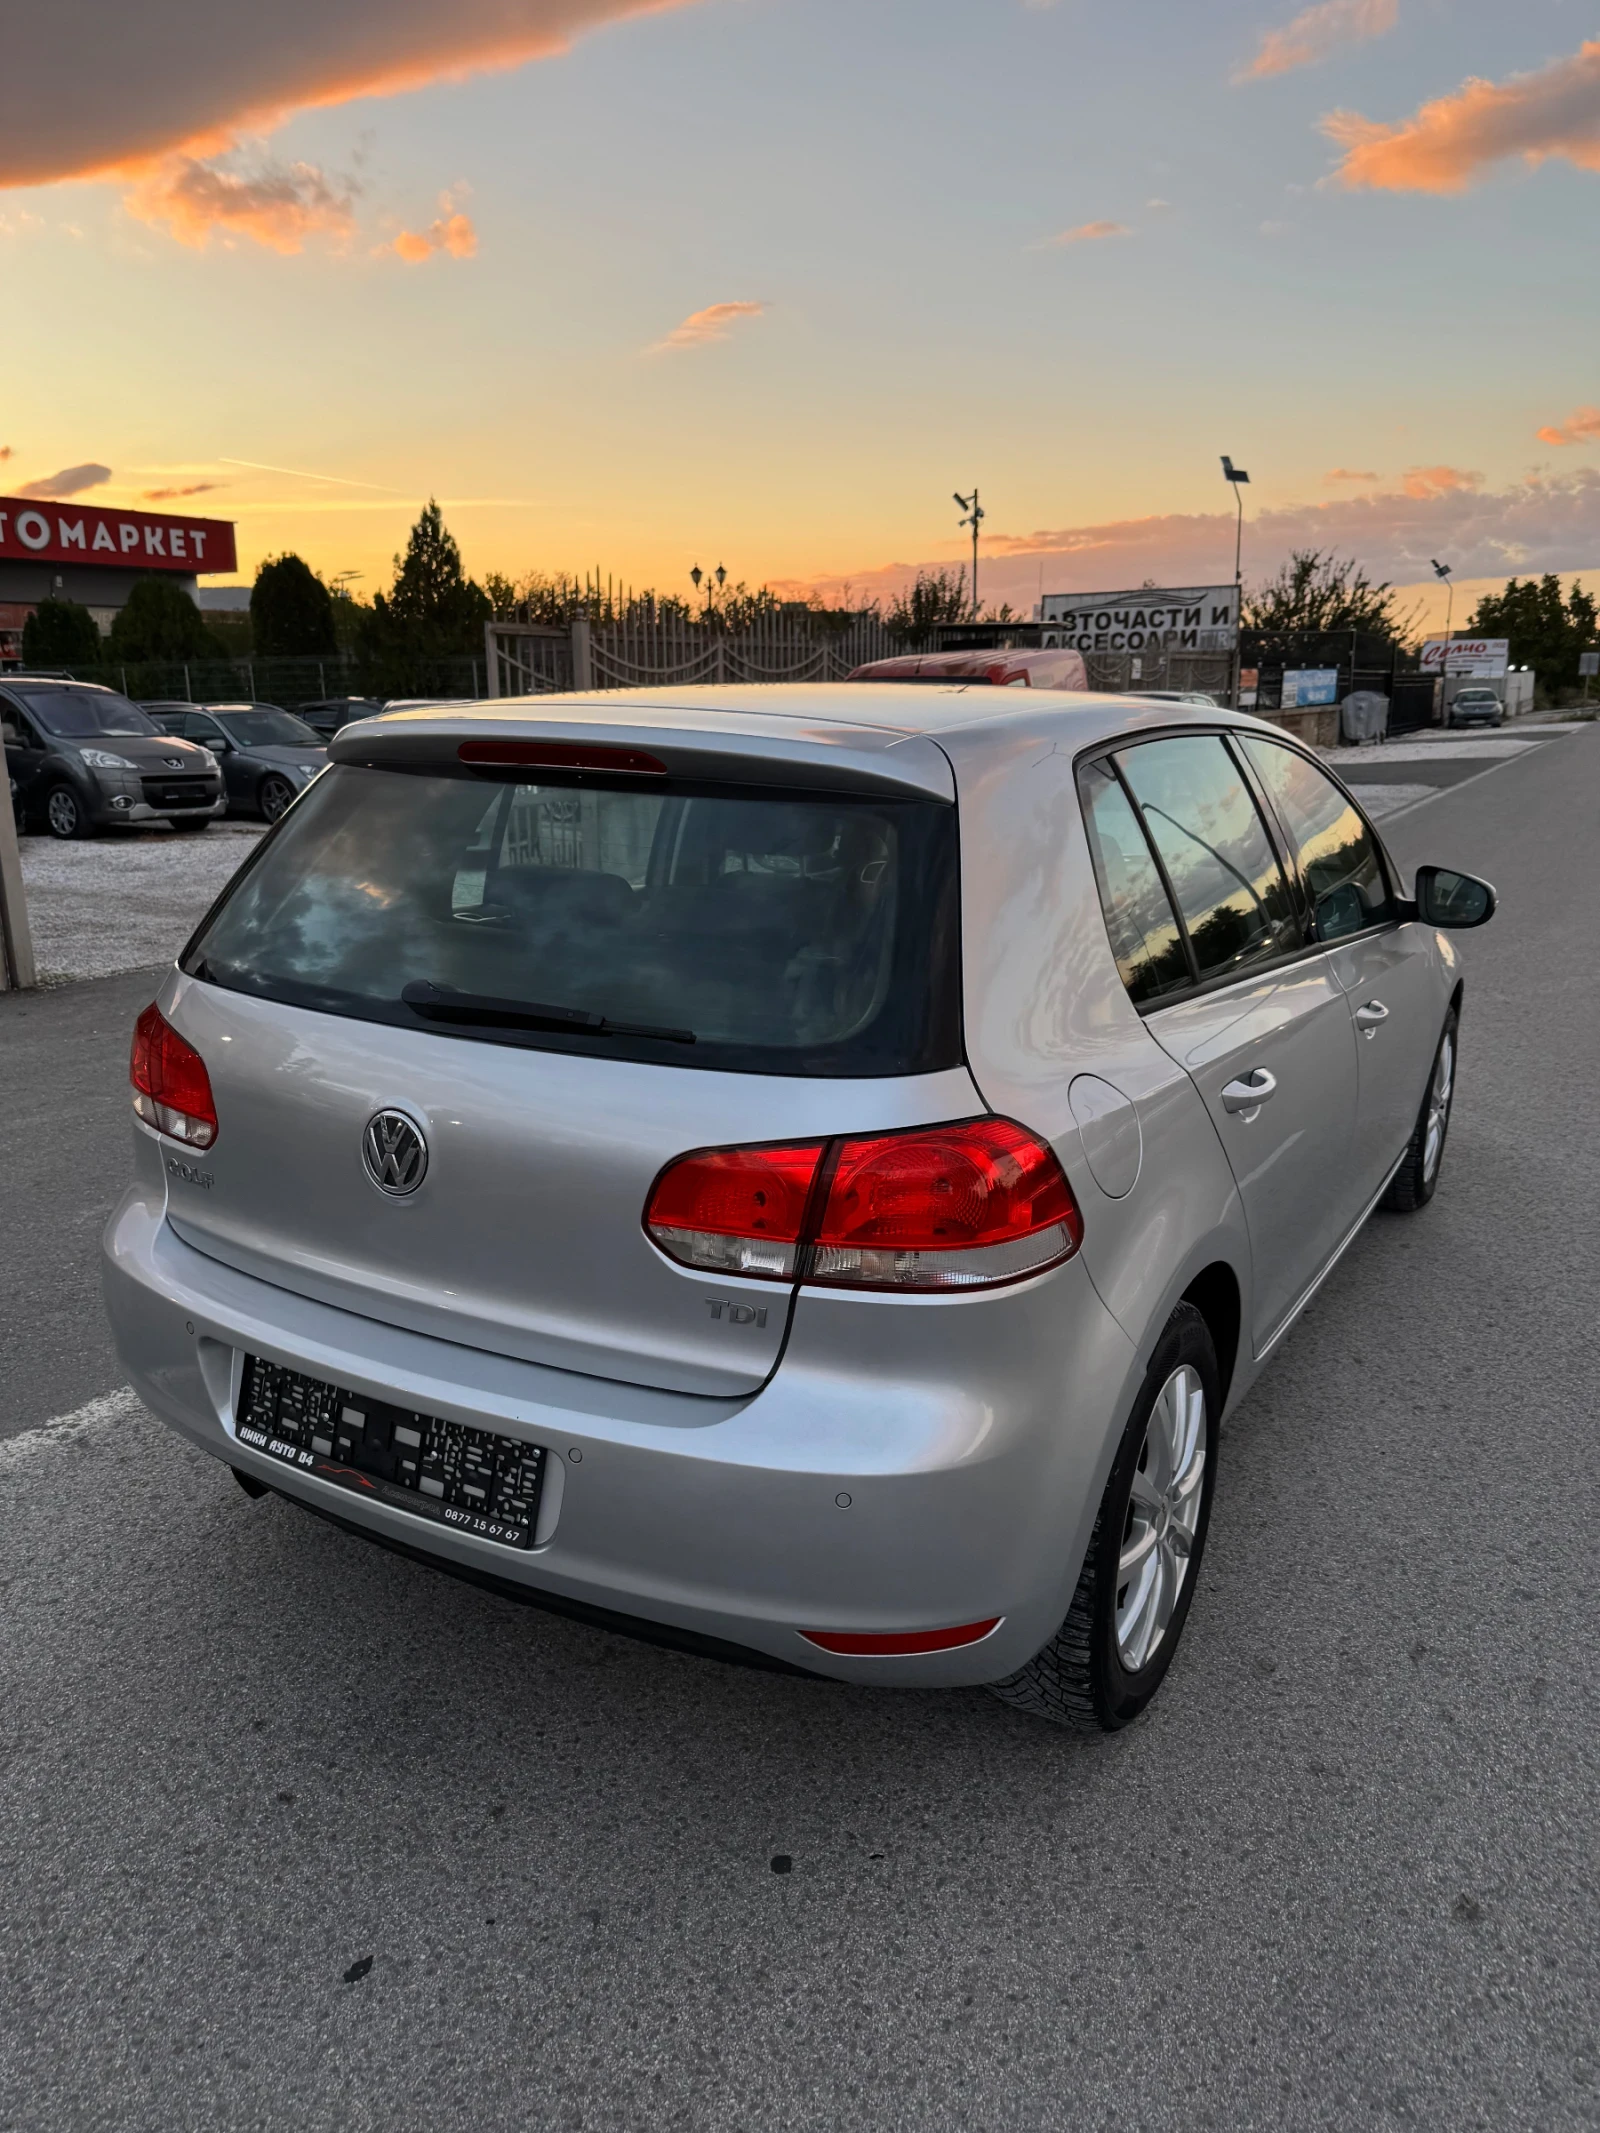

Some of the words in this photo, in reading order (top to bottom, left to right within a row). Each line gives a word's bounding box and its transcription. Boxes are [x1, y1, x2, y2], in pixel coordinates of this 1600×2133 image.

[1211, 606, 1230, 626] И
[1044, 629, 1198, 651] АКСЕСОАРИ
[167, 1157, 215, 1190] GOLF
[705, 1296, 768, 1329] TDI
[239, 1426, 268, 1447] НИКИ
[268, 1439, 297, 1459] АУТО
[444, 1508, 472, 1525] 0877
[473, 1518, 487, 1531] 15
[488, 1524, 503, 1536] 67
[505, 1530, 520, 1542] 67
